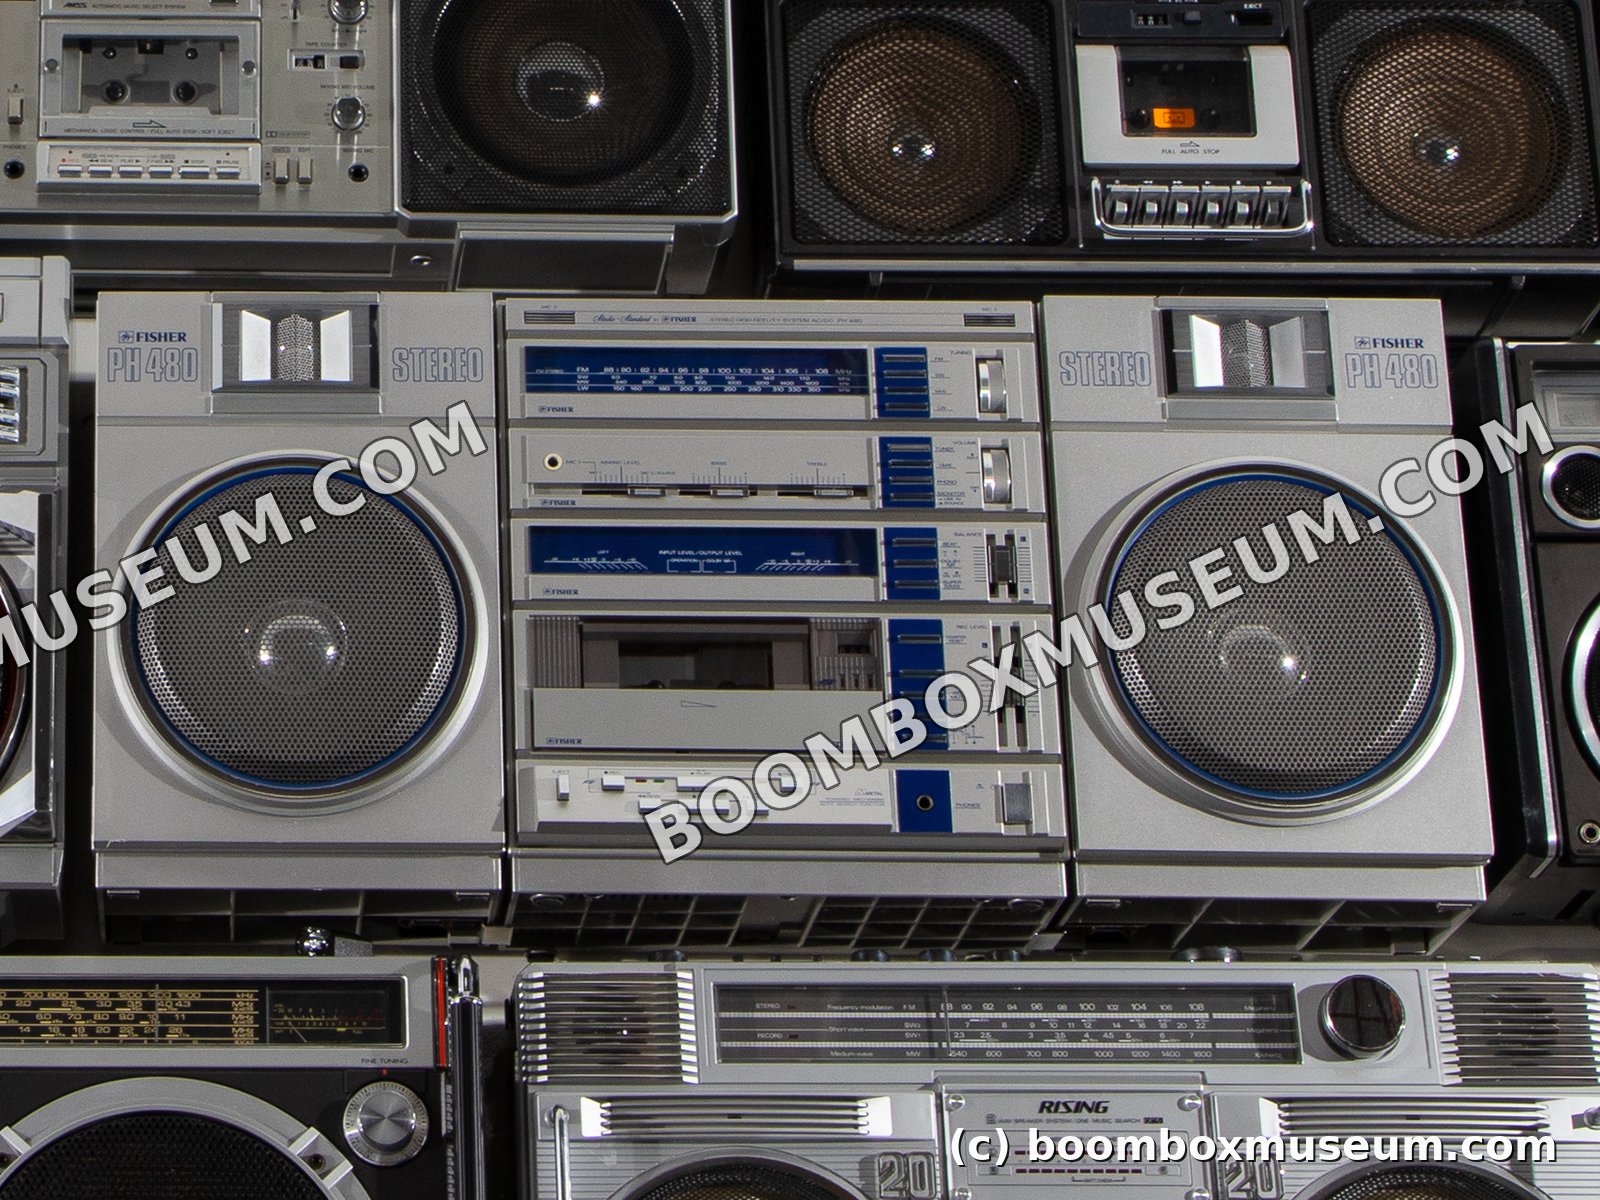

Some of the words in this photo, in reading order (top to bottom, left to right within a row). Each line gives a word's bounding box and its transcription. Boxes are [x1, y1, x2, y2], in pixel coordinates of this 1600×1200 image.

[136, 332, 187, 342] FISHER
[1373, 338, 1424, 348] FISHER
[108, 348, 141, 382] PH
[145, 348, 198, 382] 480
[392, 347, 484, 382] STEREO
[1059, 351, 1152, 387] STEREO
[1344, 353, 1382, 388] PH
[1385, 354, 1438, 388] 480
[1038, 1100, 1111, 1114] RISING
[878, 1151, 936, 1198] 20
